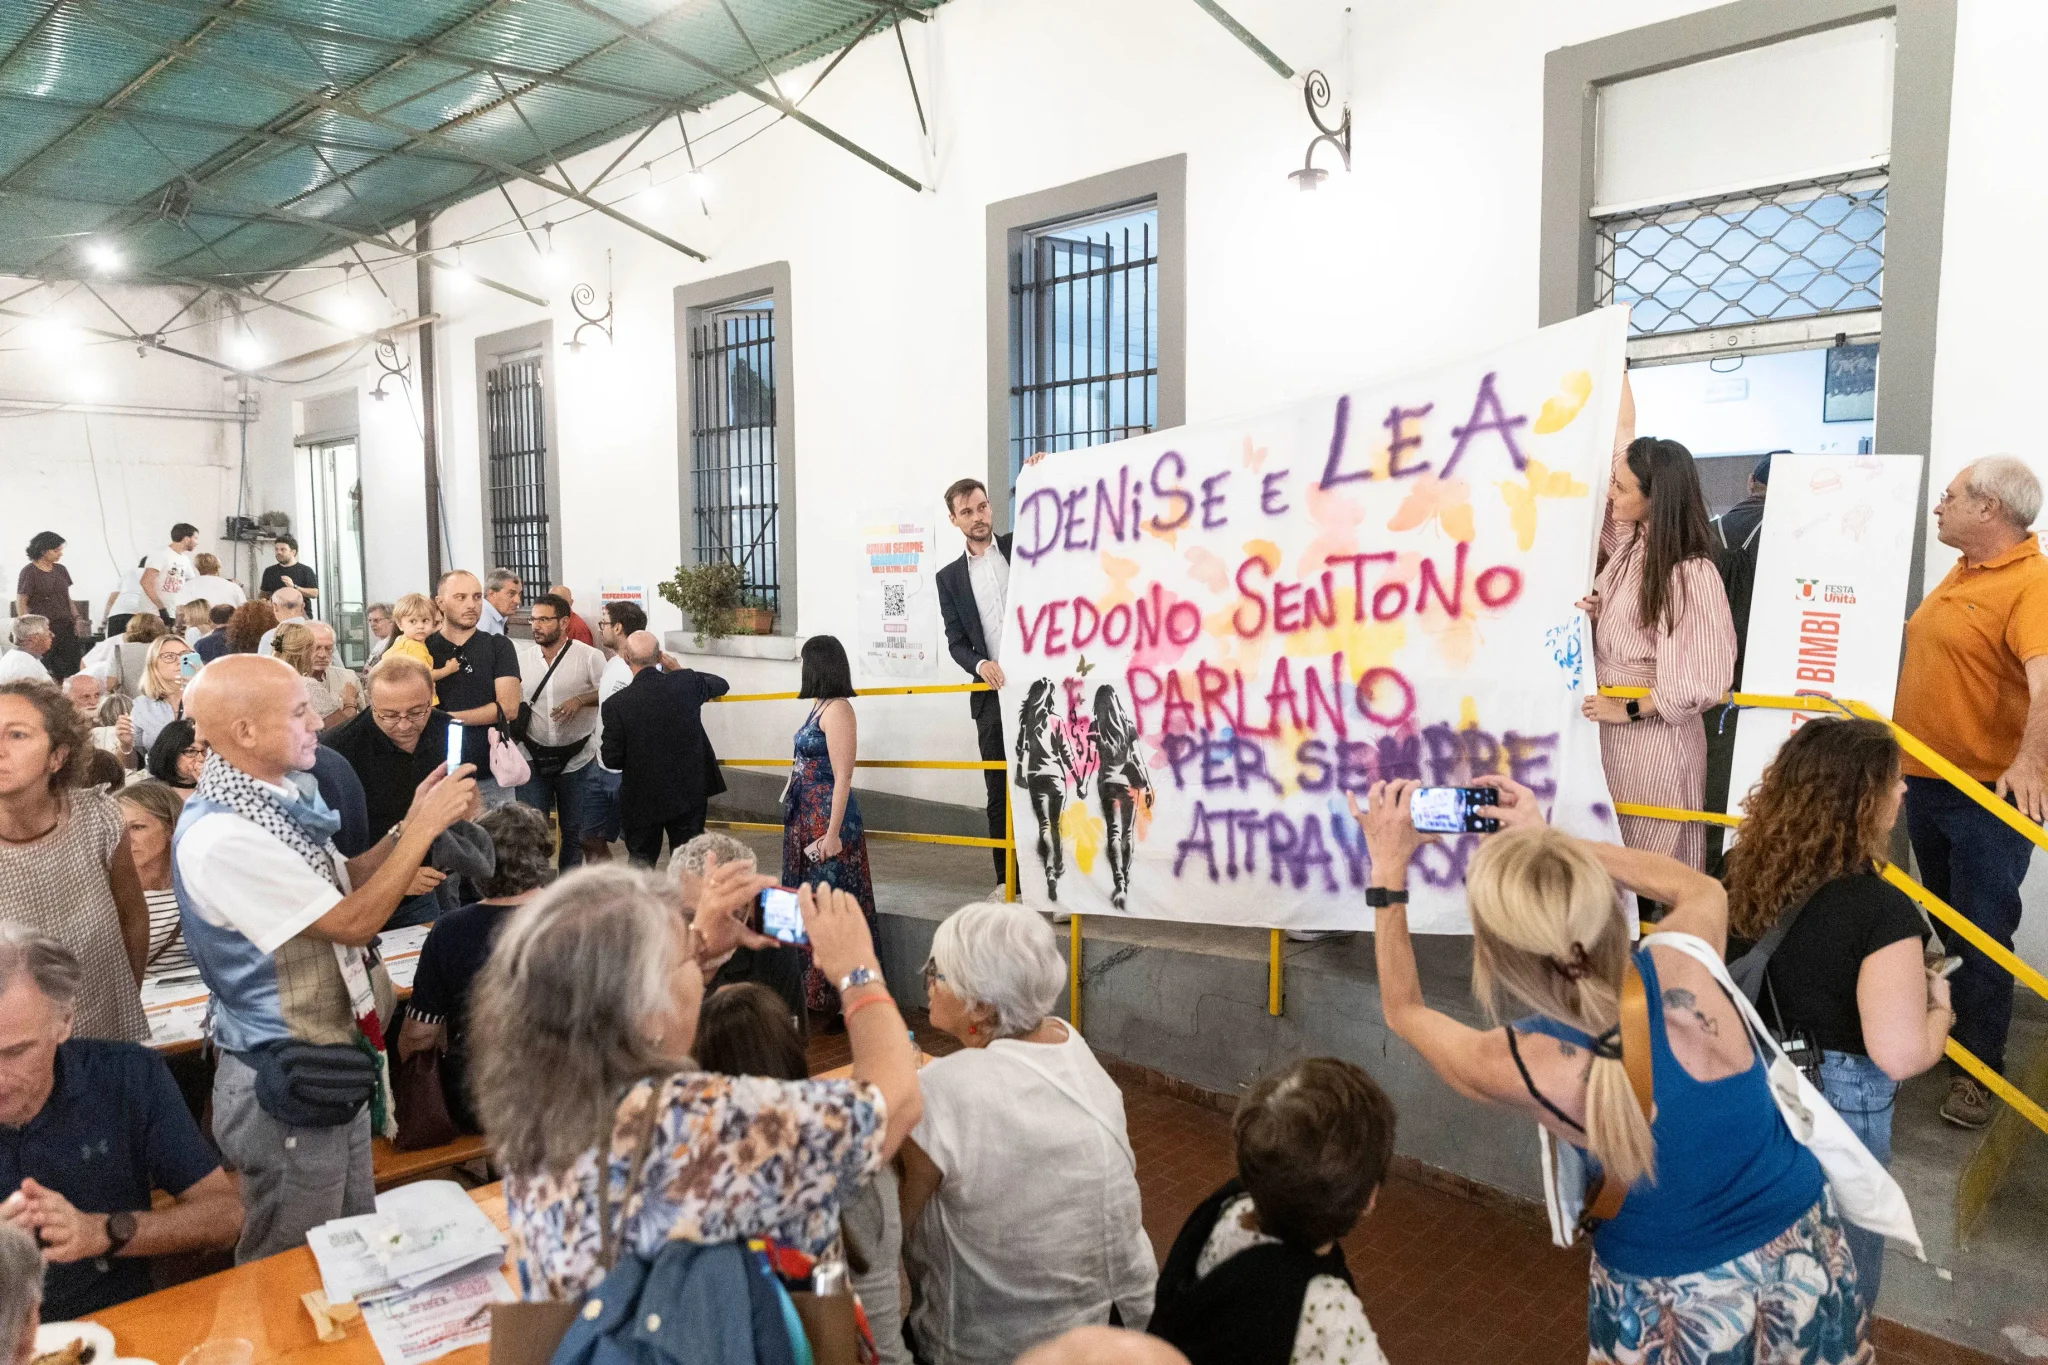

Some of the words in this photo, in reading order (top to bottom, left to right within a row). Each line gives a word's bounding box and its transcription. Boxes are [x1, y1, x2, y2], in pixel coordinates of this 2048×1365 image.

[1260, 469, 1290, 516] E
[1318, 371, 1529, 491] LEA
[893, 541, 924, 553] SEMPRE
[1017, 581, 1202, 659] VEDONO
[1233, 540, 1525, 639] SENTONO
[1825, 585, 1854, 594] FESTA
[1796, 610, 1841, 683] BIMBI
[1125, 651, 1417, 741] PARLANO
[1162, 724, 1284, 796] PER
